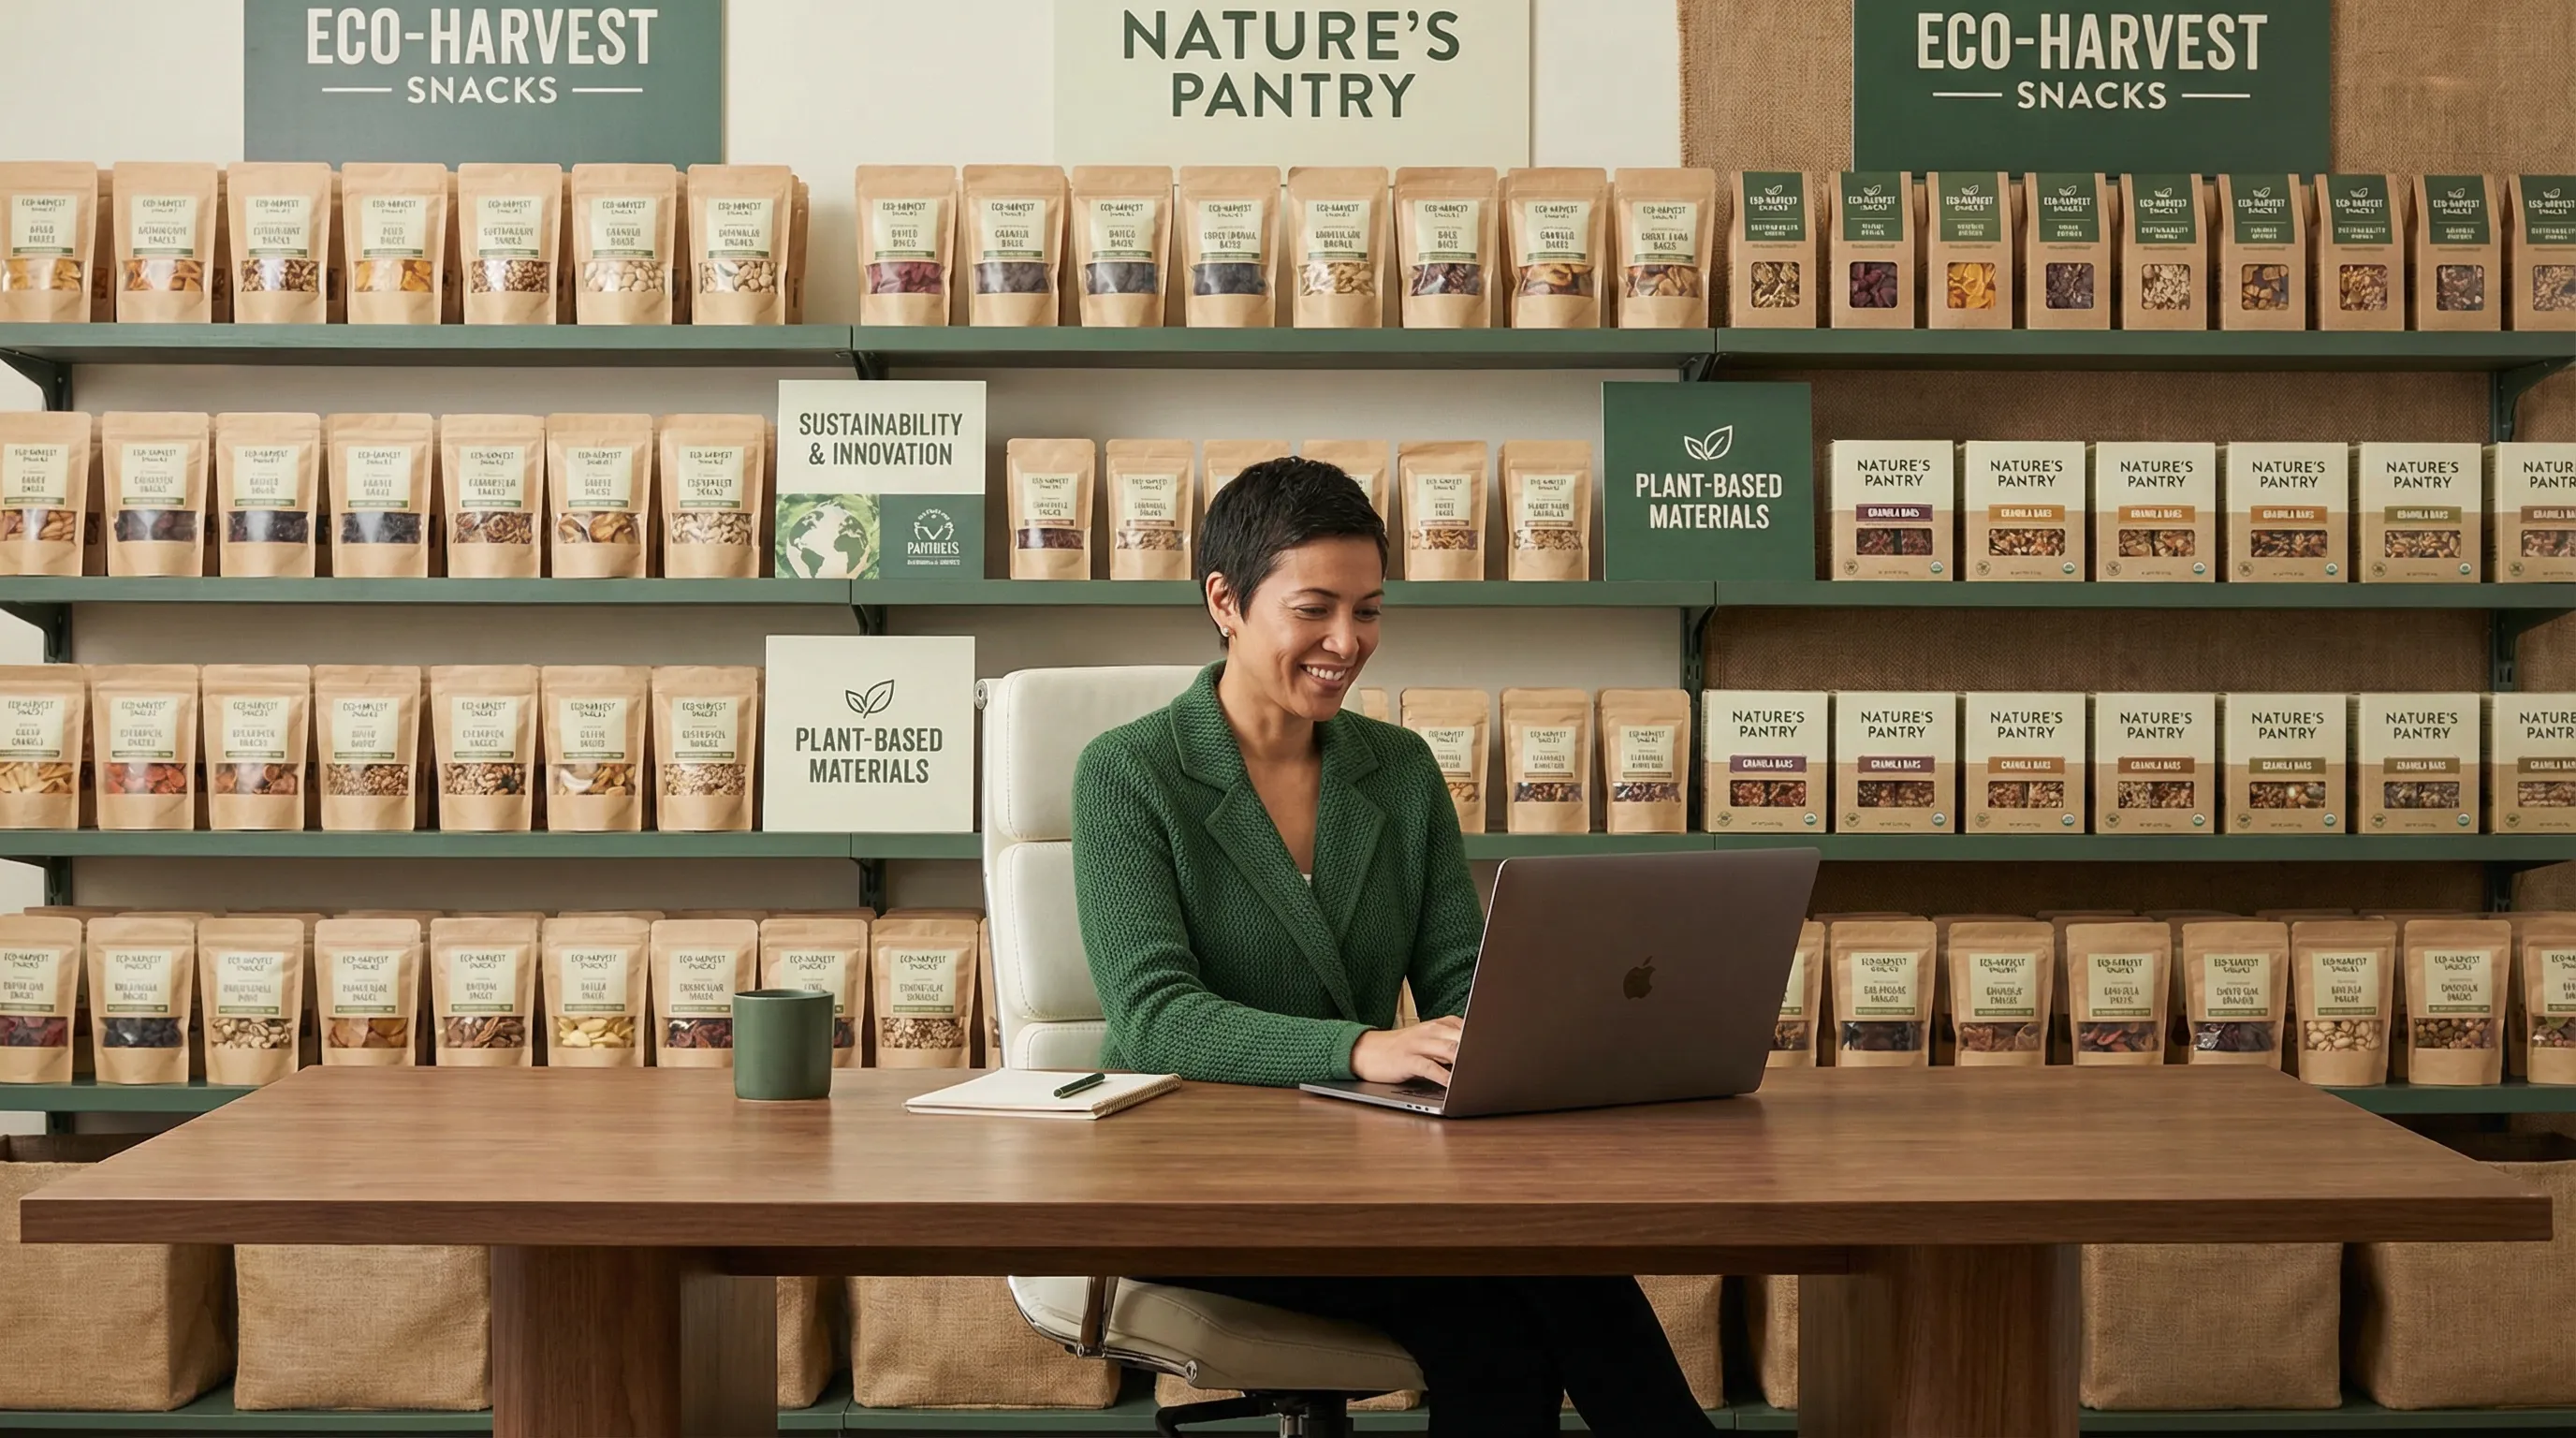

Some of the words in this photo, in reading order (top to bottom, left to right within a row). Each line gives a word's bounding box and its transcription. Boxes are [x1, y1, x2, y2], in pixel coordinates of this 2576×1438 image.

[307, 8, 658, 65] ECO-HARVEST
[1123, 9, 1460, 61] NATURE'S
[1917, 12, 2268, 70] ECO-HARVEST
[407, 76, 558, 104] SNACKS
[1172, 72, 1416, 118] PANTRY
[2017, 81, 2167, 110] SNACKS
[798, 412, 963, 436] SUSTAINABILITY
[808, 442, 826, 465] &
[832, 442, 953, 465] INNOVATION
[2524, 462, 2573, 473] NATUR
[1635, 473, 1783, 499] PLANT-BASED
[1866, 475, 1924, 486] PANTRY
[1998, 475, 2056, 487] PANTRY
[2129, 476, 2186, 487] PANTRY
[2261, 476, 2318, 488] PANTRY
[2394, 477, 2452, 488] PANTRY
[2530, 477, 2576, 488] PANTR
[1649, 504, 1770, 530] MATERIALS
[2520, 712, 2576, 724] NATURE
[1740, 726, 1797, 738] PANTRY
[1868, 726, 1925, 738] PANTRY
[1998, 726, 2055, 738] PANTRY
[2128, 726, 2185, 739] PANTRY
[2260, 727, 2317, 739] PANTRY
[2394, 727, 2451, 739] PANTRY
[2527, 726, 2574, 739] PANTR
[796, 727, 943, 752] PLANT-BASED
[810, 758, 929, 784] MATERIALS
